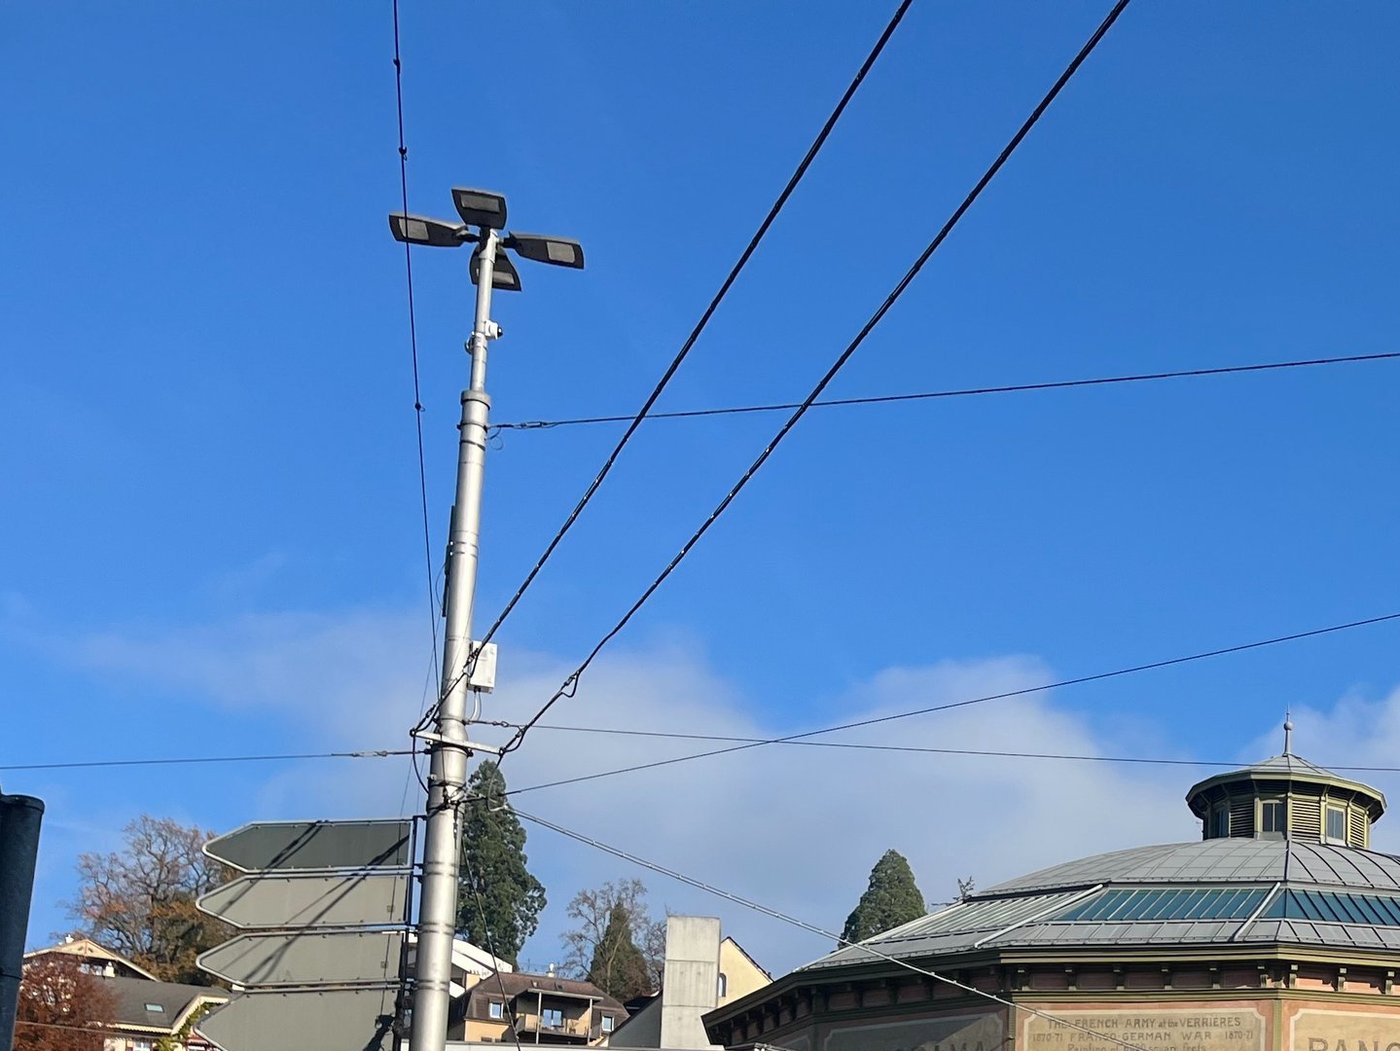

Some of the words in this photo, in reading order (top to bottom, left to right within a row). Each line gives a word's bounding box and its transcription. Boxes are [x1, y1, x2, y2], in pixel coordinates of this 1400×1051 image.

[1075, 1018, 1119, 1029] FRENCH
[1126, 1018, 1157, 1029] ARMY
[1182, 1031, 1212, 1041] WAR
